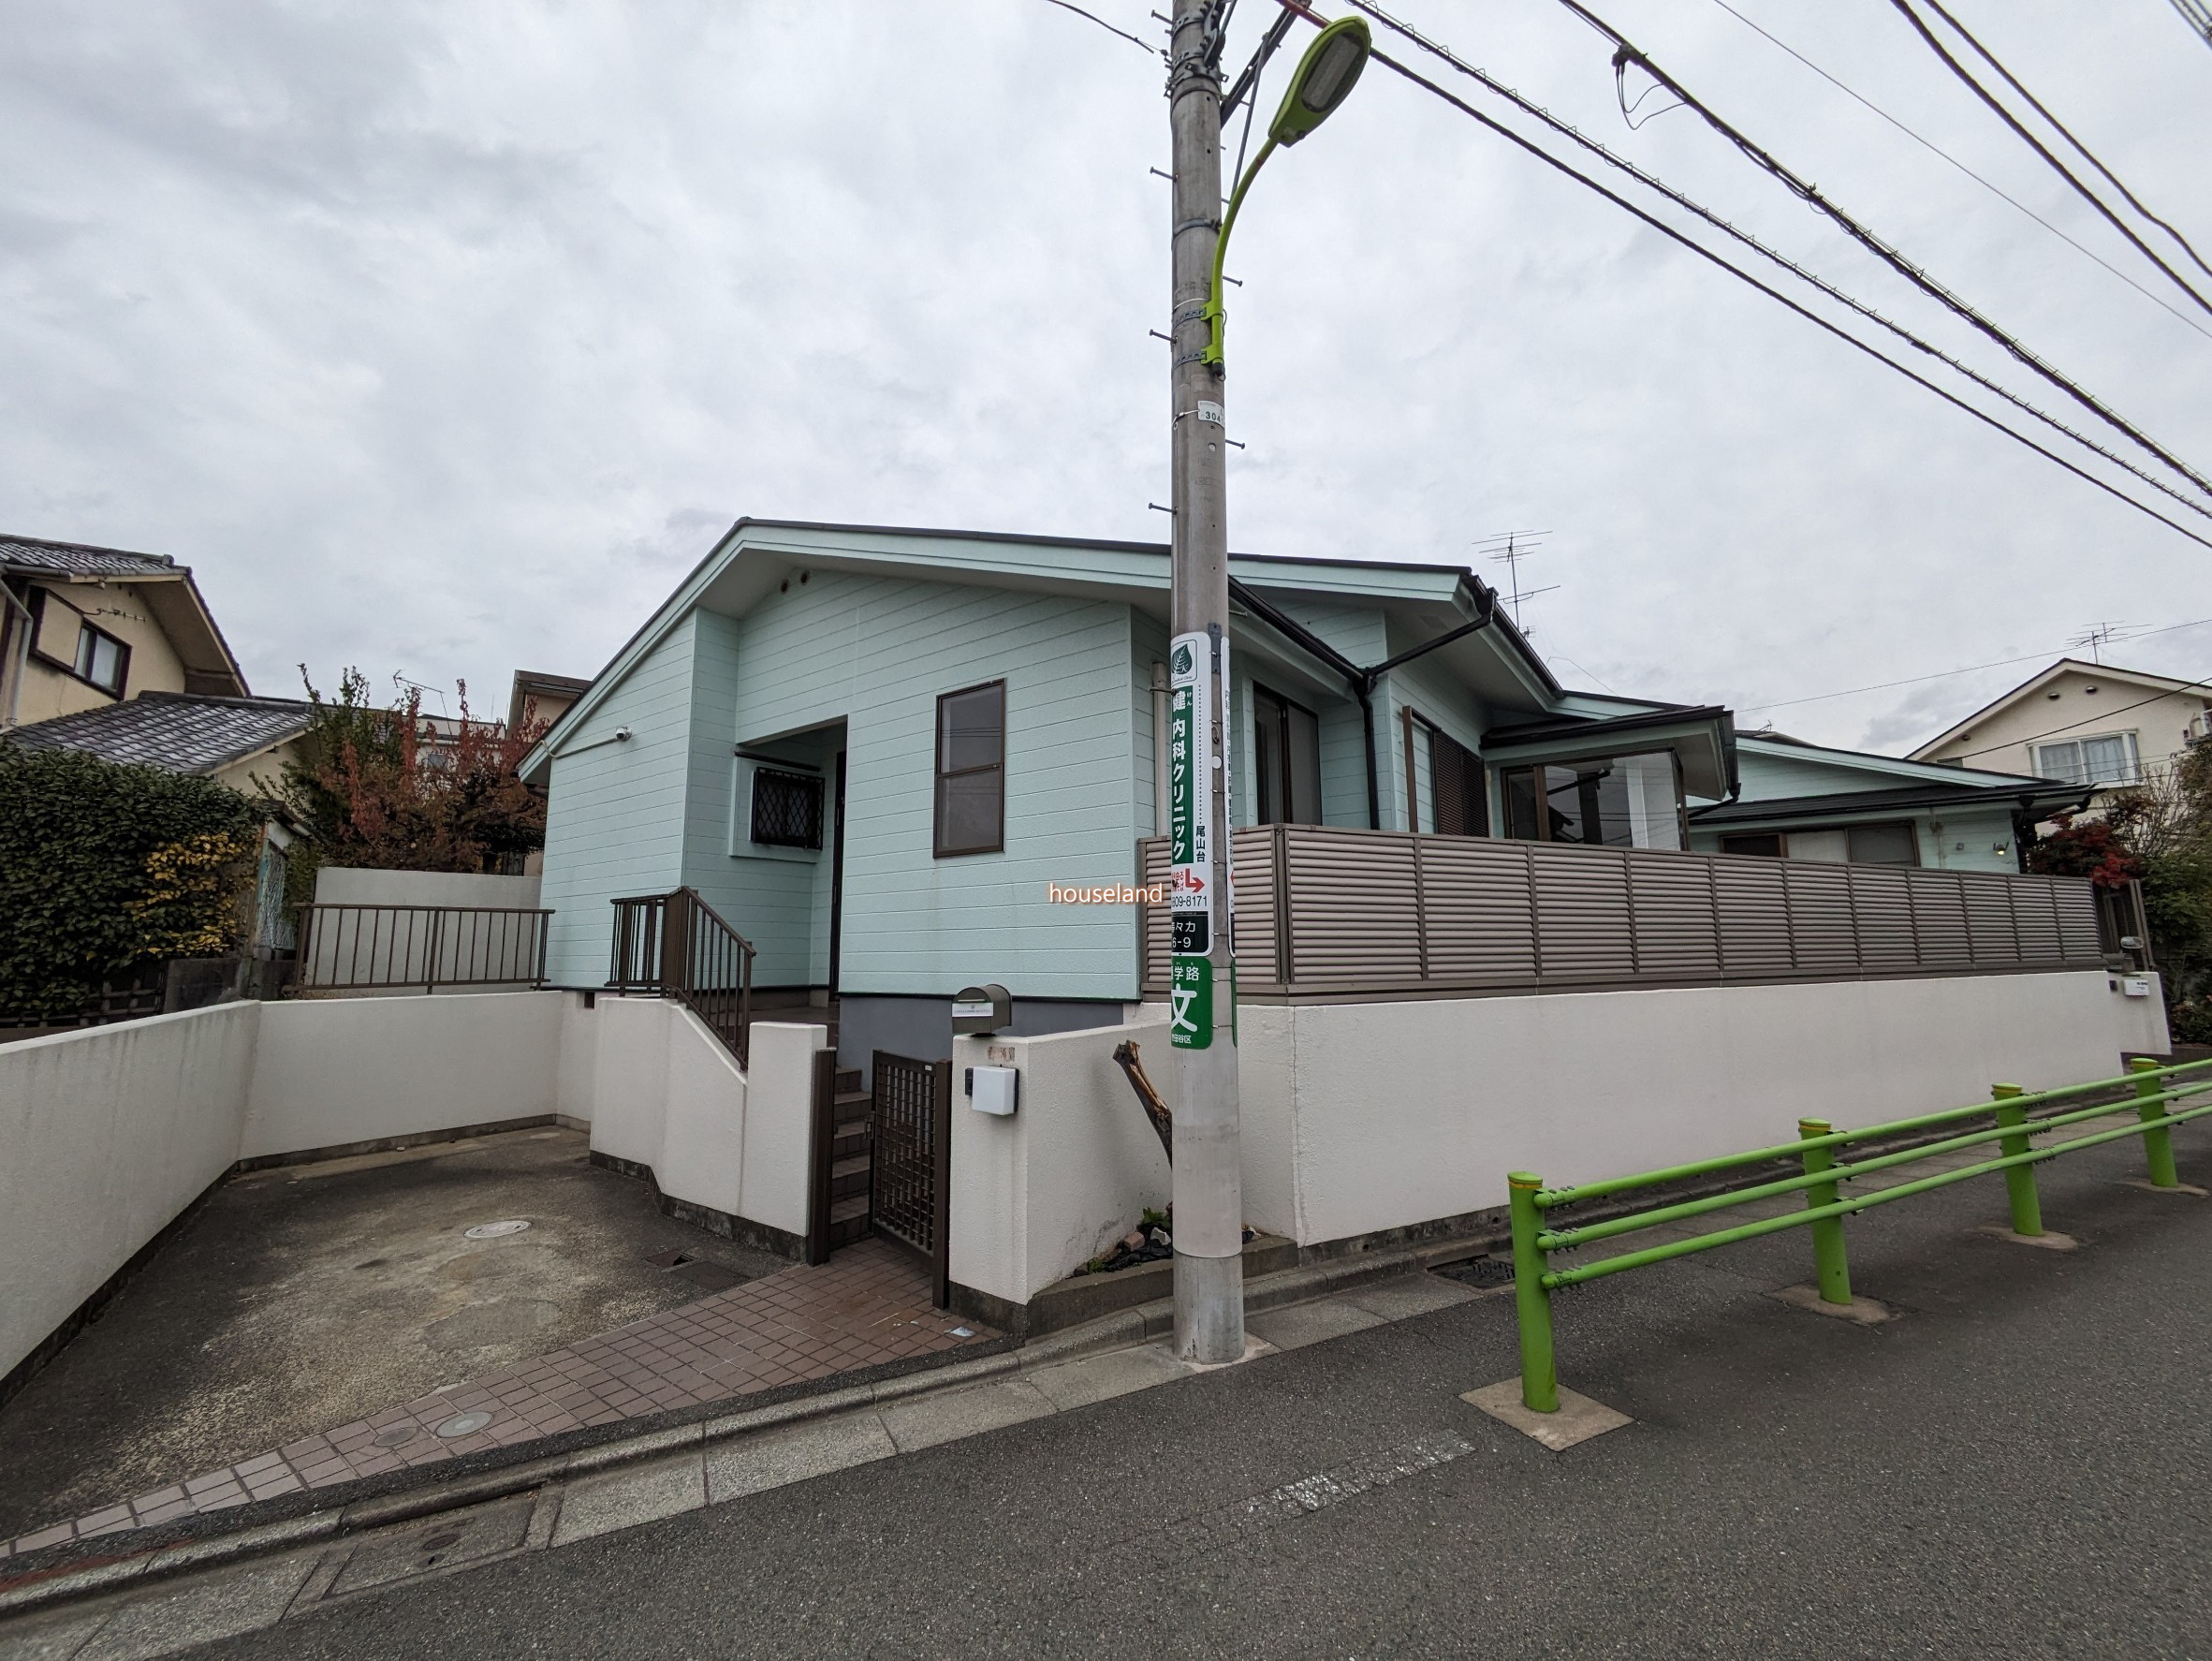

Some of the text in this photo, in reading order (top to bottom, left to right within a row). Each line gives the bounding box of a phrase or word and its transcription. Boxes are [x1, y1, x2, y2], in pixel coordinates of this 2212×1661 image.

[1195, 825, 1206, 862] 尾山台
[1171, 965, 1200, 981] 学路
